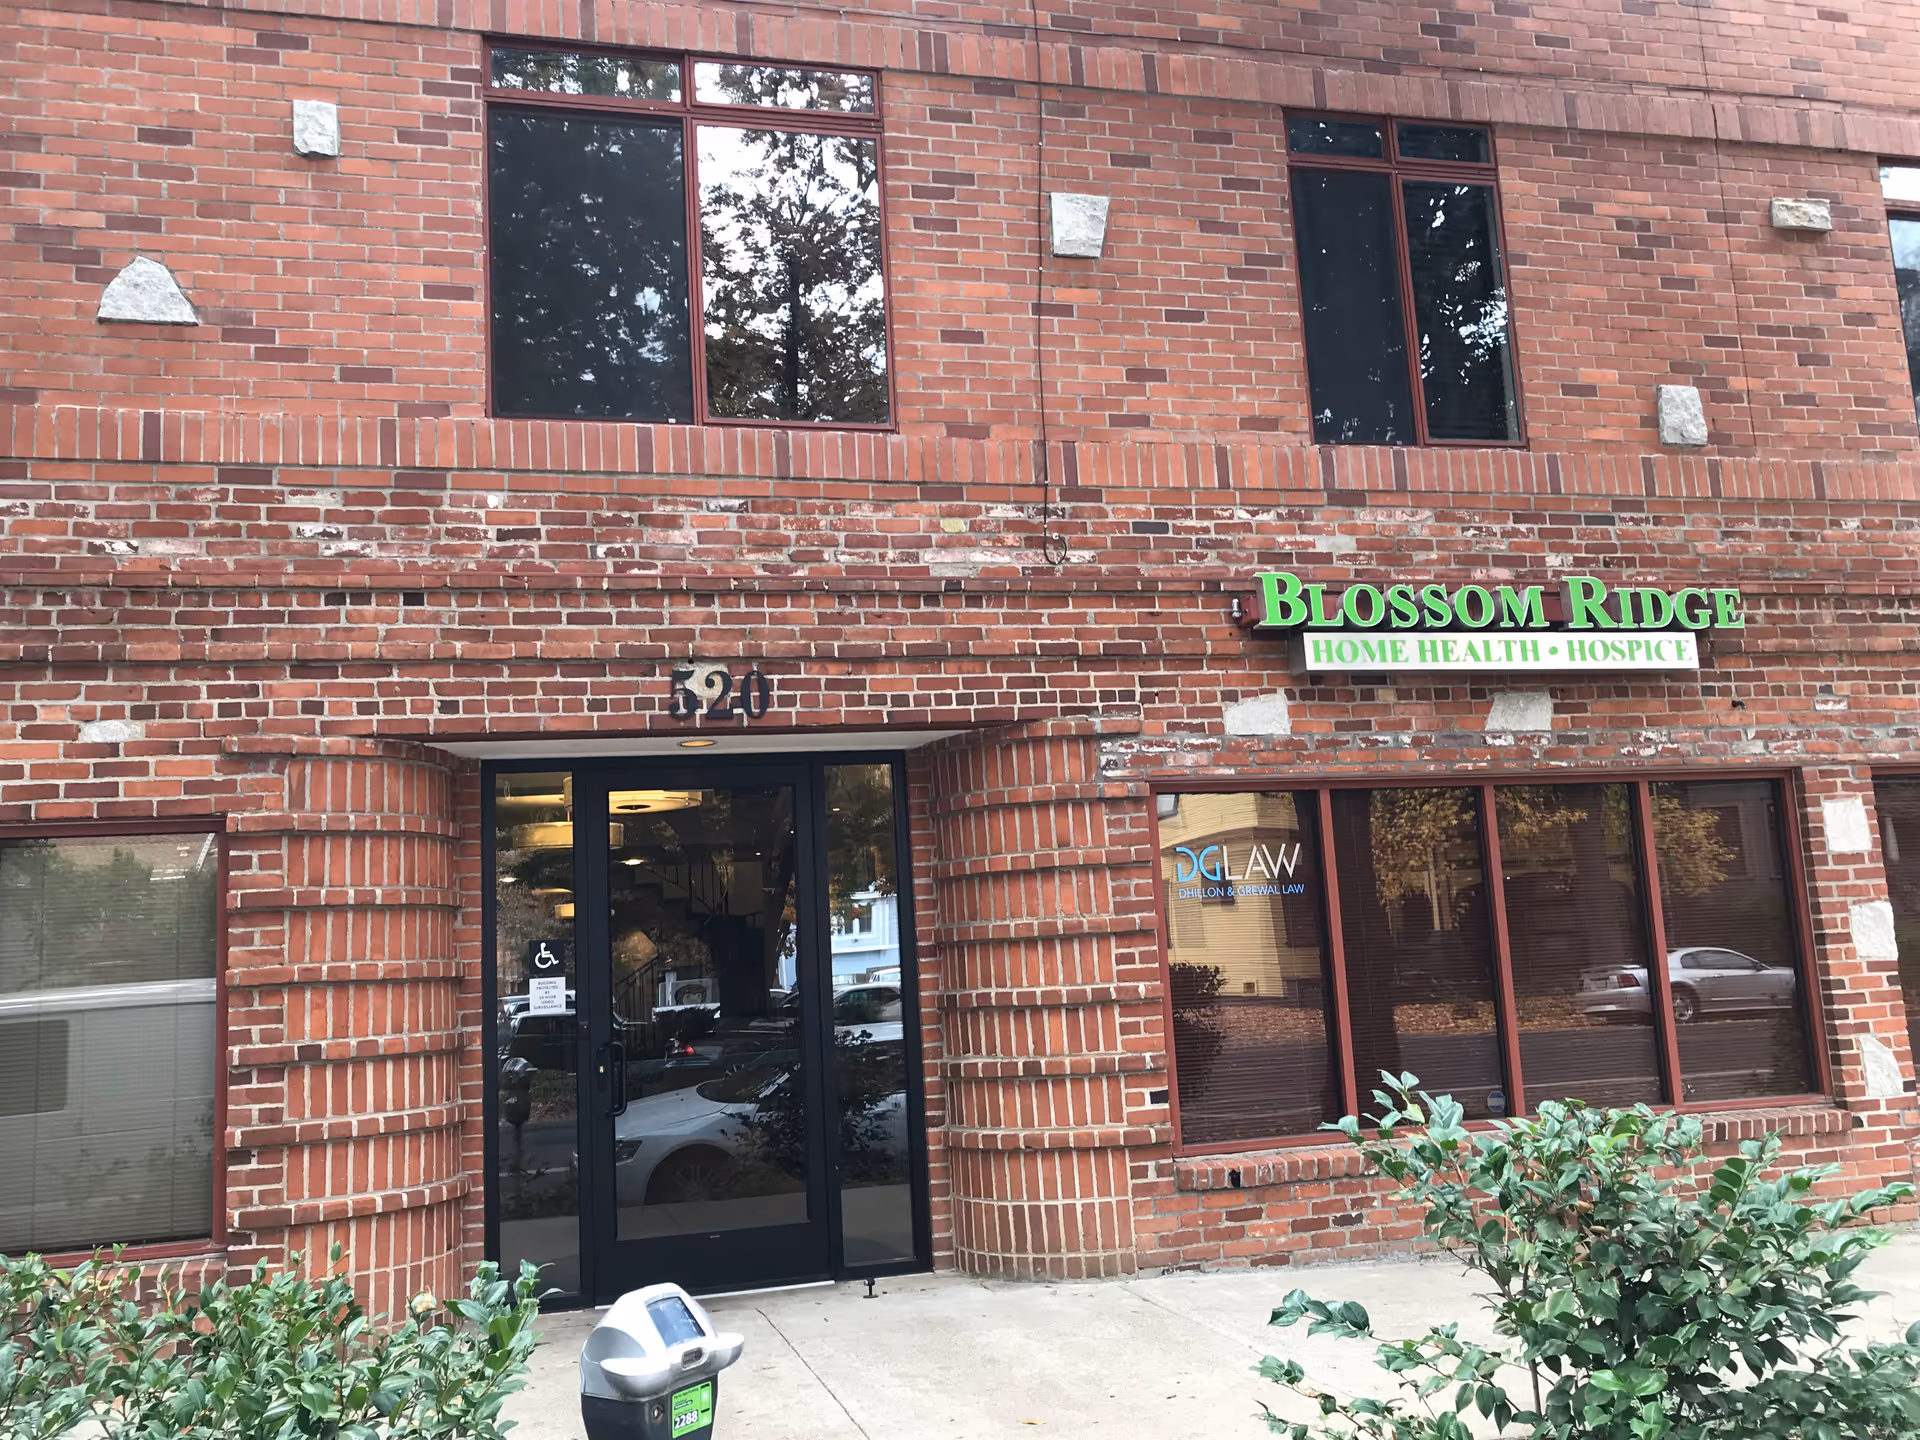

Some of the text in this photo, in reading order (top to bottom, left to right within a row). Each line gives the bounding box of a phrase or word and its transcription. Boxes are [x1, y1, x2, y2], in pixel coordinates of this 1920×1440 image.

[1257, 571, 1745, 629] BLOSSOM RIDGE
[1312, 639, 1410, 663] HOME
[1418, 639, 1541, 663] HEALTH
[1566, 639, 1693, 662] HOSPICE
[669, 670, 770, 720] 520
[1178, 884, 1304, 899] DHILLON & GREWAL LAW
[674, 1410, 698, 1430] 2288
